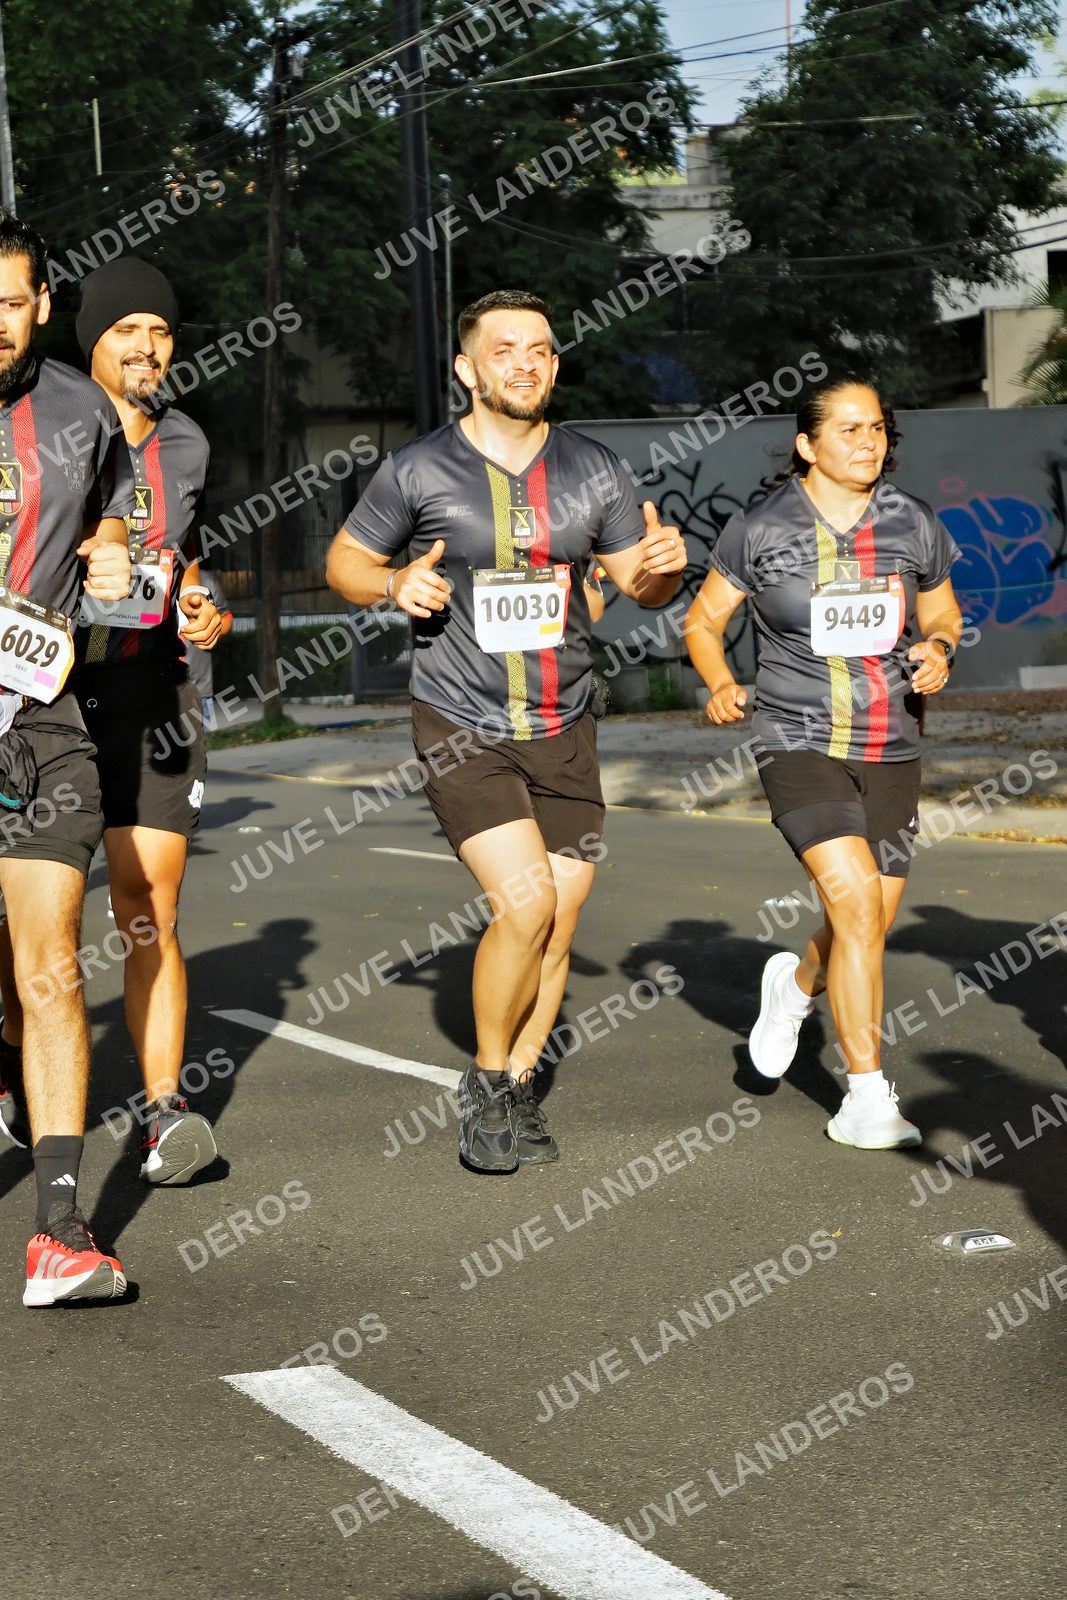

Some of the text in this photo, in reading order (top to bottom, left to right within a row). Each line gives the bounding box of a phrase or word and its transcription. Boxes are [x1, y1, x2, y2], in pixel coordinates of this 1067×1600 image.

[481, 593, 560, 623] 10030
[824, 603, 887, 631] 9449
[1, 624, 60, 667] 6029
